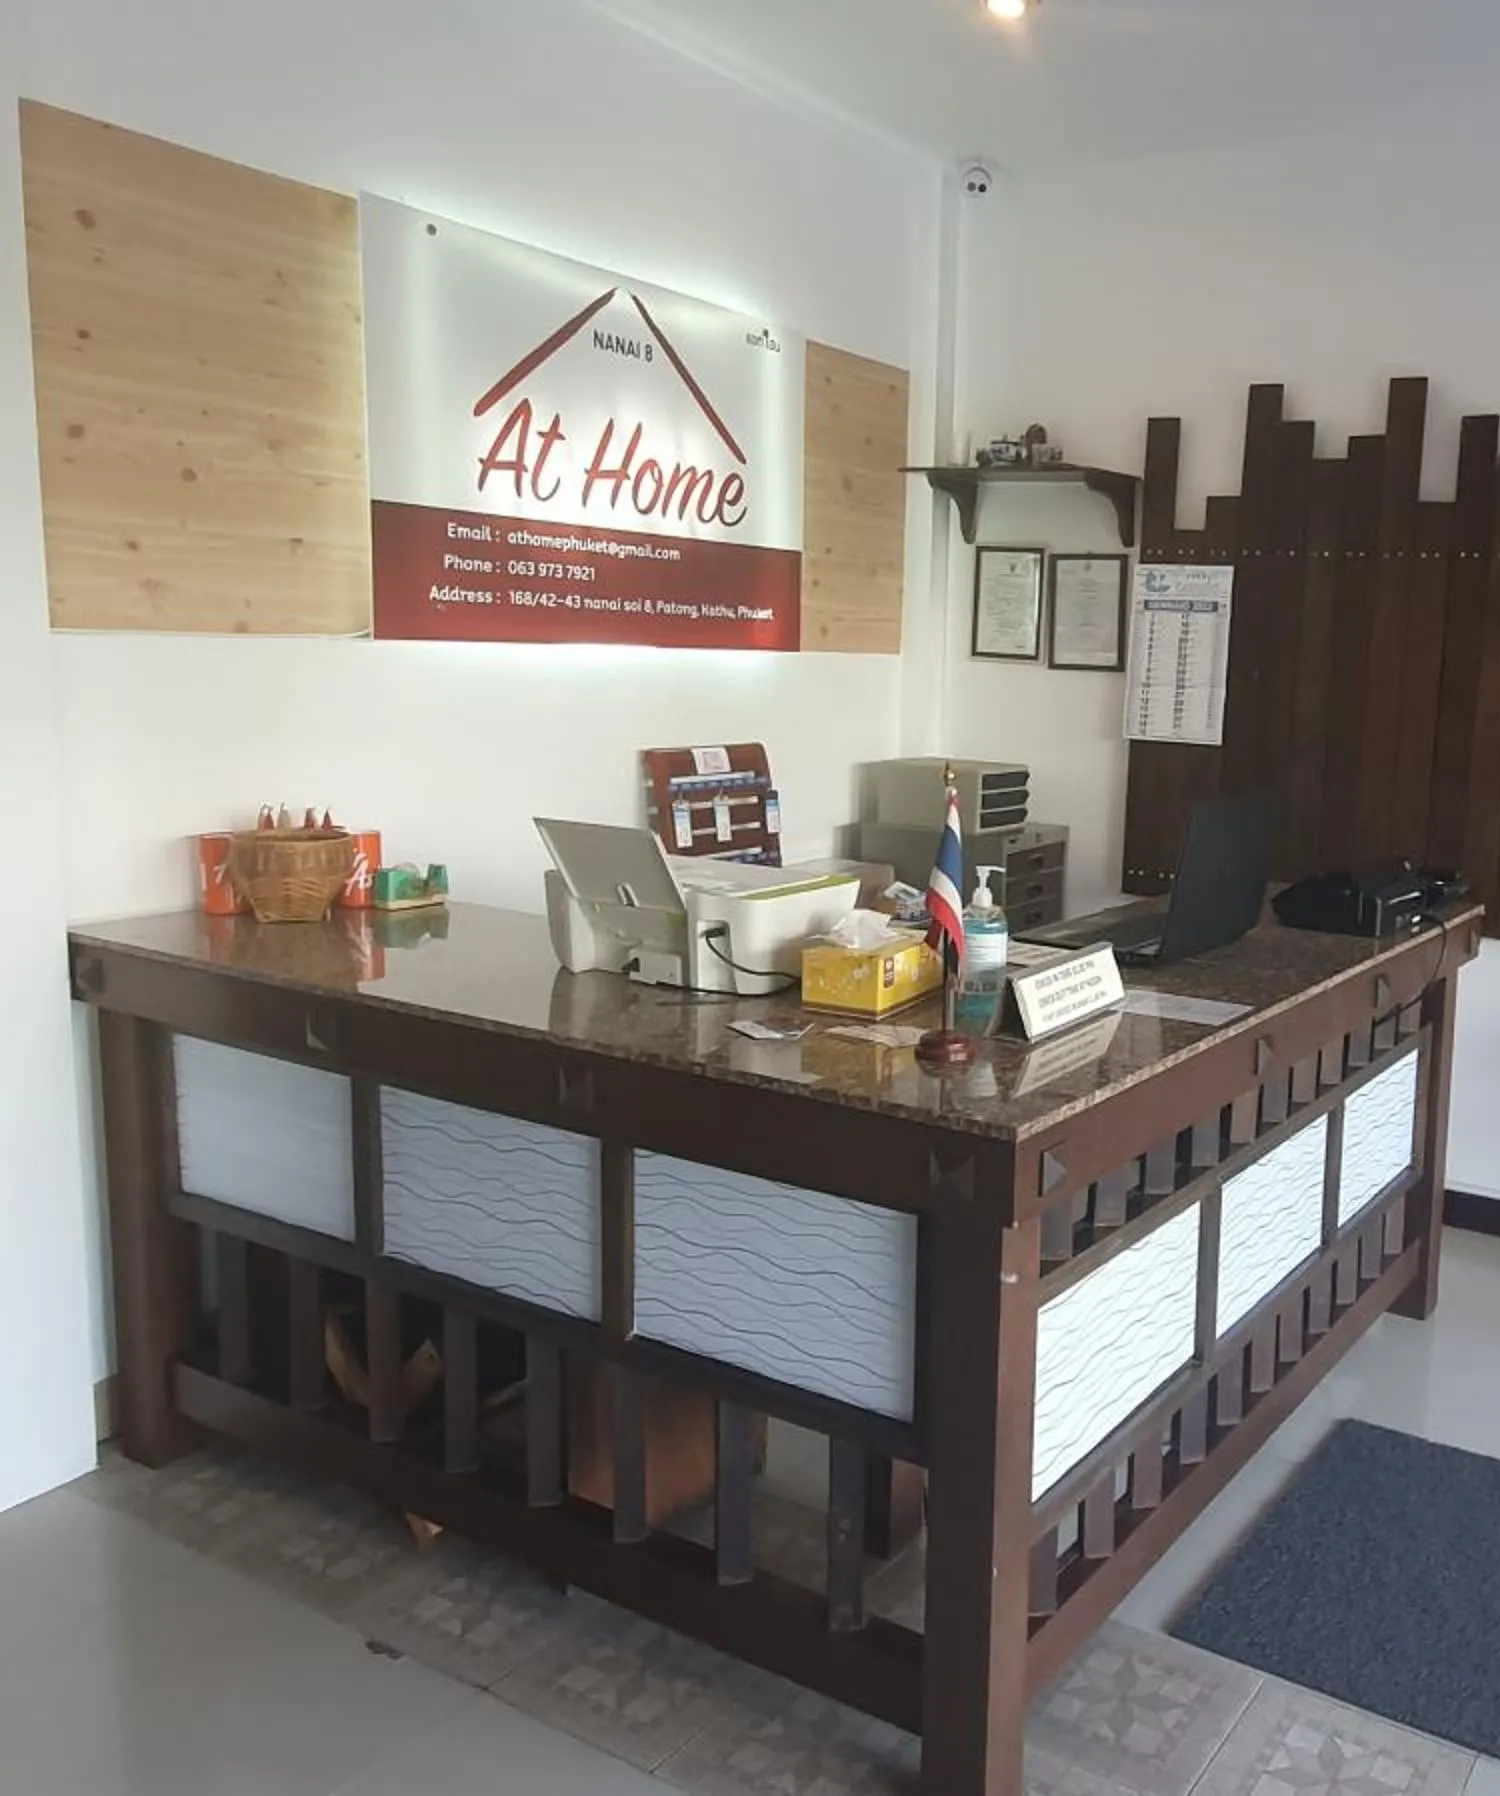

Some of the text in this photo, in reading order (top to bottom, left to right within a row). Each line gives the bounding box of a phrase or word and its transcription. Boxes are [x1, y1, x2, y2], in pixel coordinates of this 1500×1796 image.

[593, 329, 654, 362] NANAI 8
[478, 397, 747, 527] At Home
[507, 529, 681, 560] athomephuket@gmail.com
[507, 560, 535, 576] 063
[538, 562, 563, 579] 973
[567, 565, 596, 581] 7921
[509, 590, 581, 609] 168/42-43
[584, 596, 621, 612] nanai
[623, 598, 642, 613] soi
